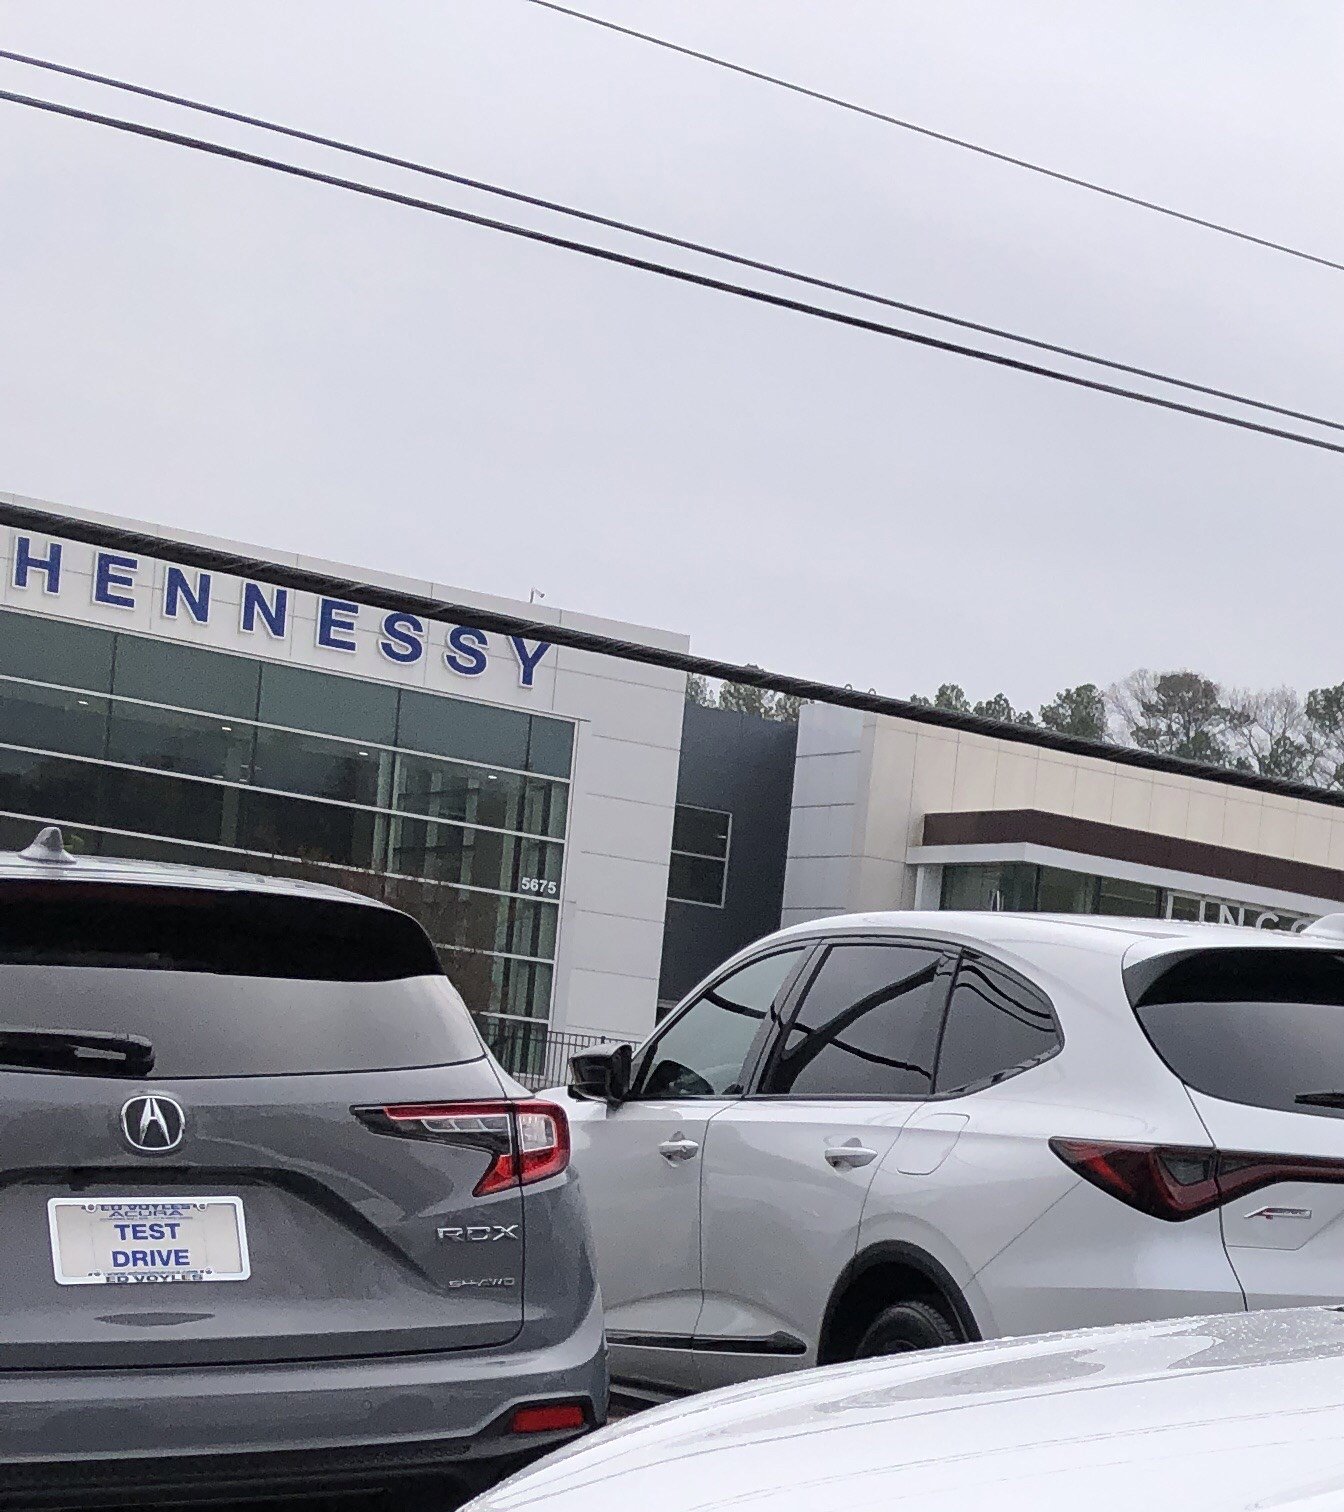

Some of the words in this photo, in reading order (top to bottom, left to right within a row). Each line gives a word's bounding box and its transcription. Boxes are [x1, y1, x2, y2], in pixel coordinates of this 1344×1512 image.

[12, 534, 553, 689] HENNESSY
[521, 876, 557, 895] 5675
[113, 1222, 181, 1241] TEST
[437, 1224, 519, 1241] RDX
[111, 1248, 191, 1268] DRIVE
